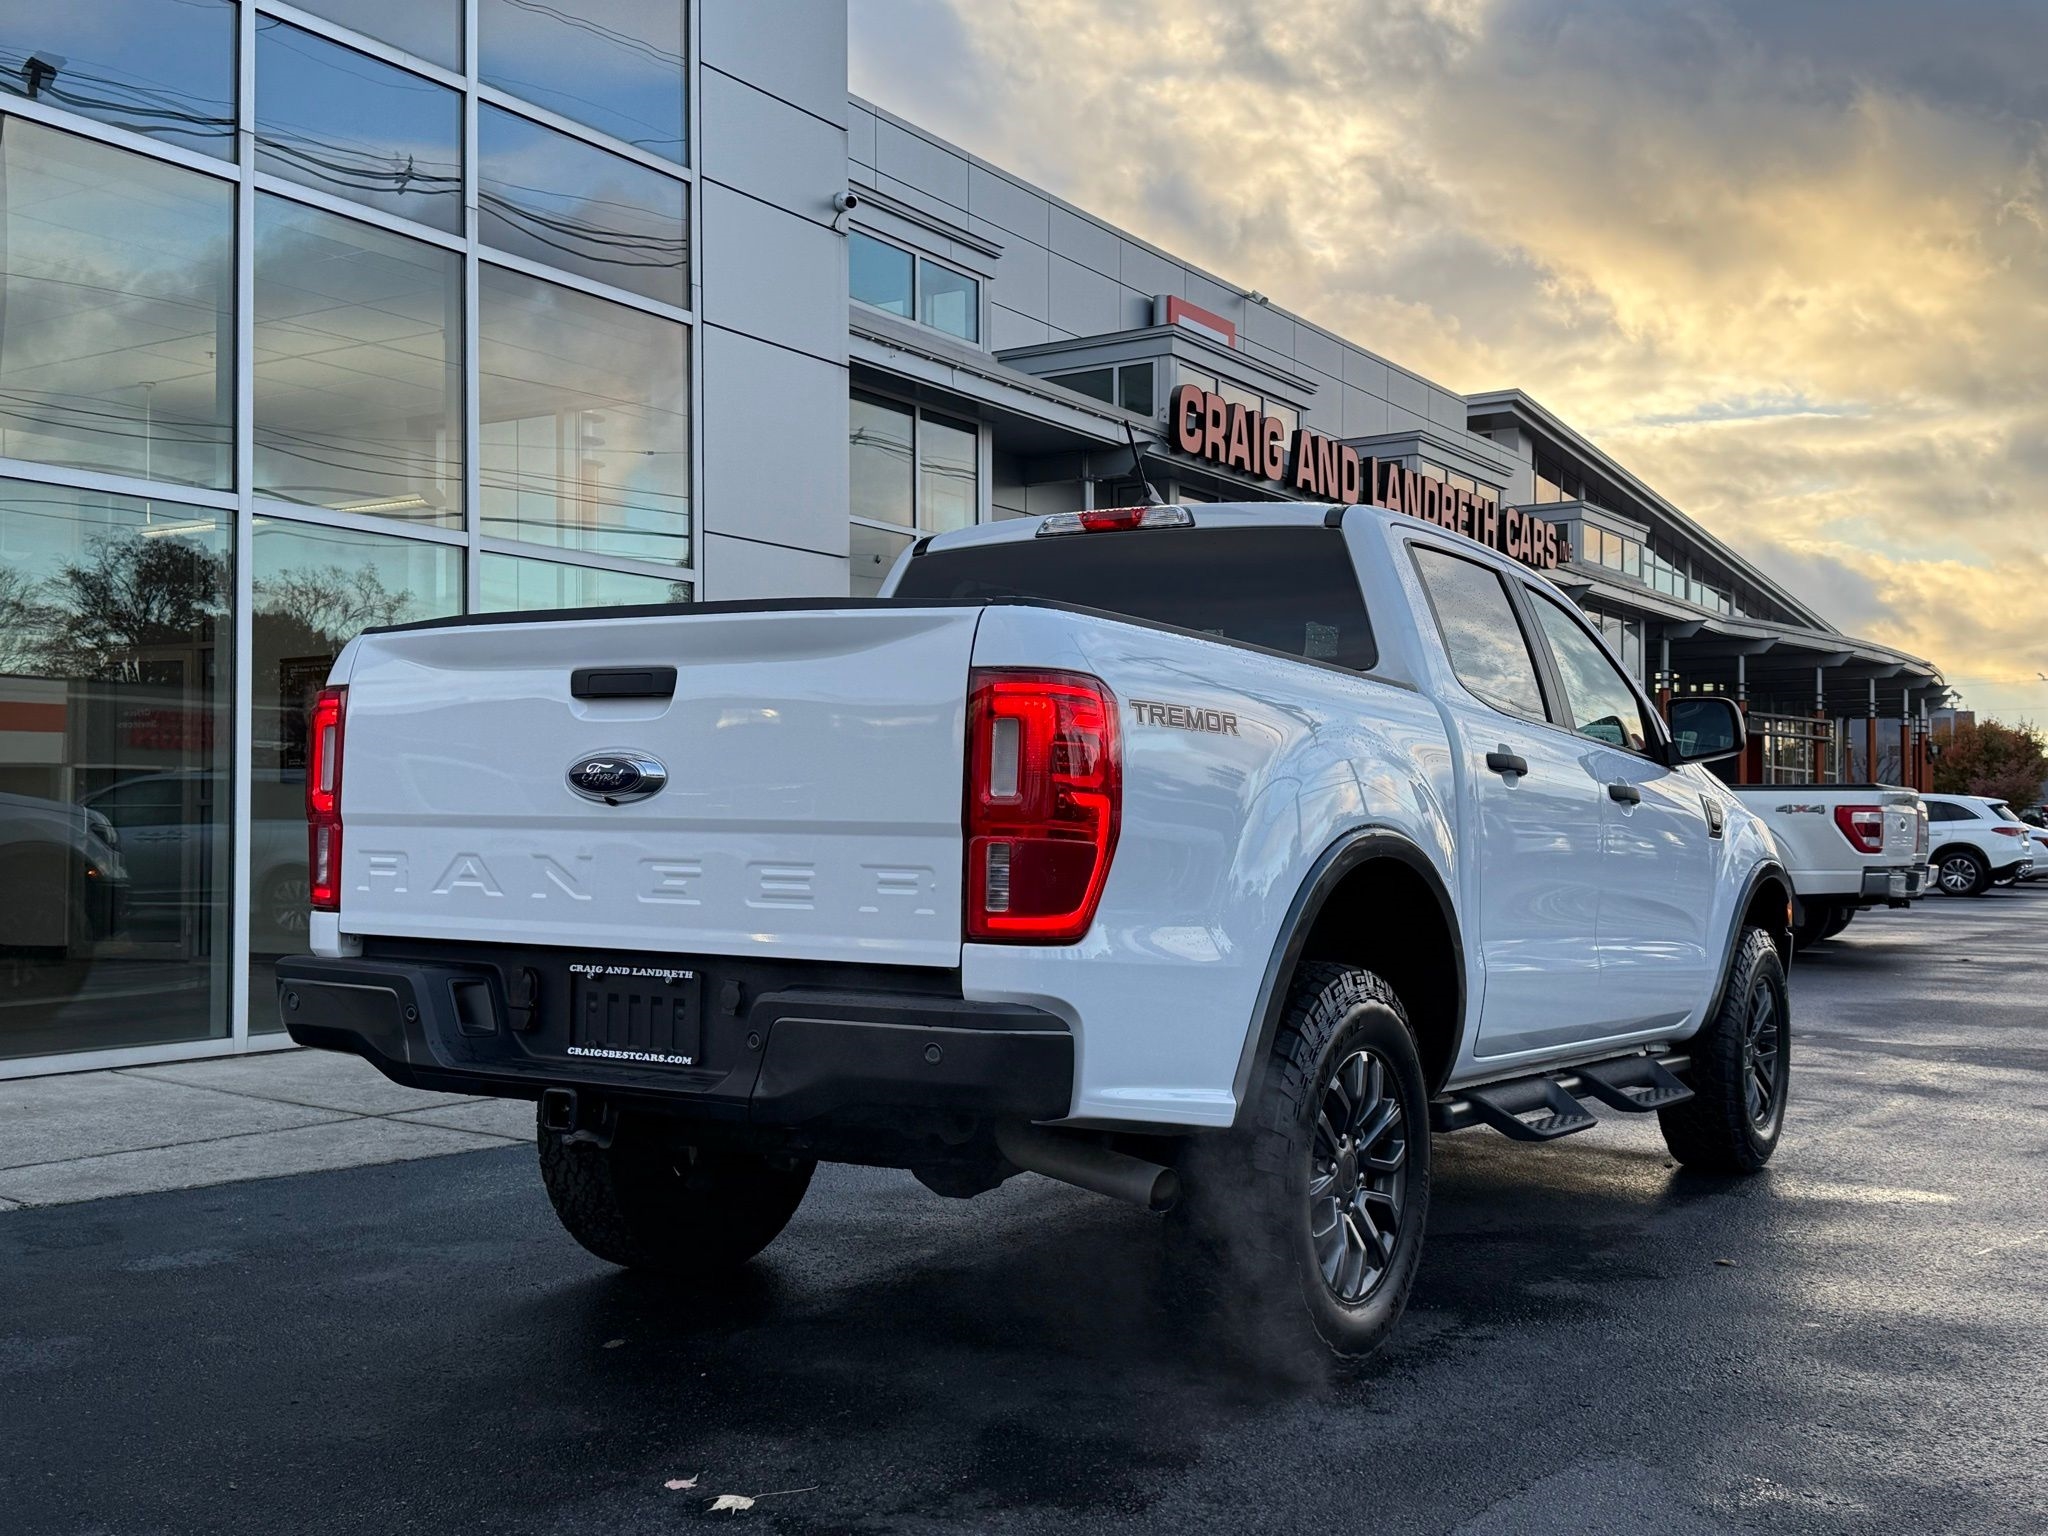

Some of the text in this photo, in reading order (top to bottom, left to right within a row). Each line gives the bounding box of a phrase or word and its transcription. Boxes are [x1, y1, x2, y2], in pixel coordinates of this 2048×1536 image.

[1176, 384, 1284, 481] CRAIG
[1296, 429, 1360, 505] AND
[1371, 456, 1498, 550] LANDRETH
[1506, 508, 1557, 569] CARS
[1129, 699, 1240, 736] TREMOR
[581, 762, 625, 786] Ford
[356, 849, 937, 915] RANGER
[569, 964, 693, 979] CRAIG AND LANDRETH
[567, 1046, 693, 1065] CRAIGSBESTCARS.COM
